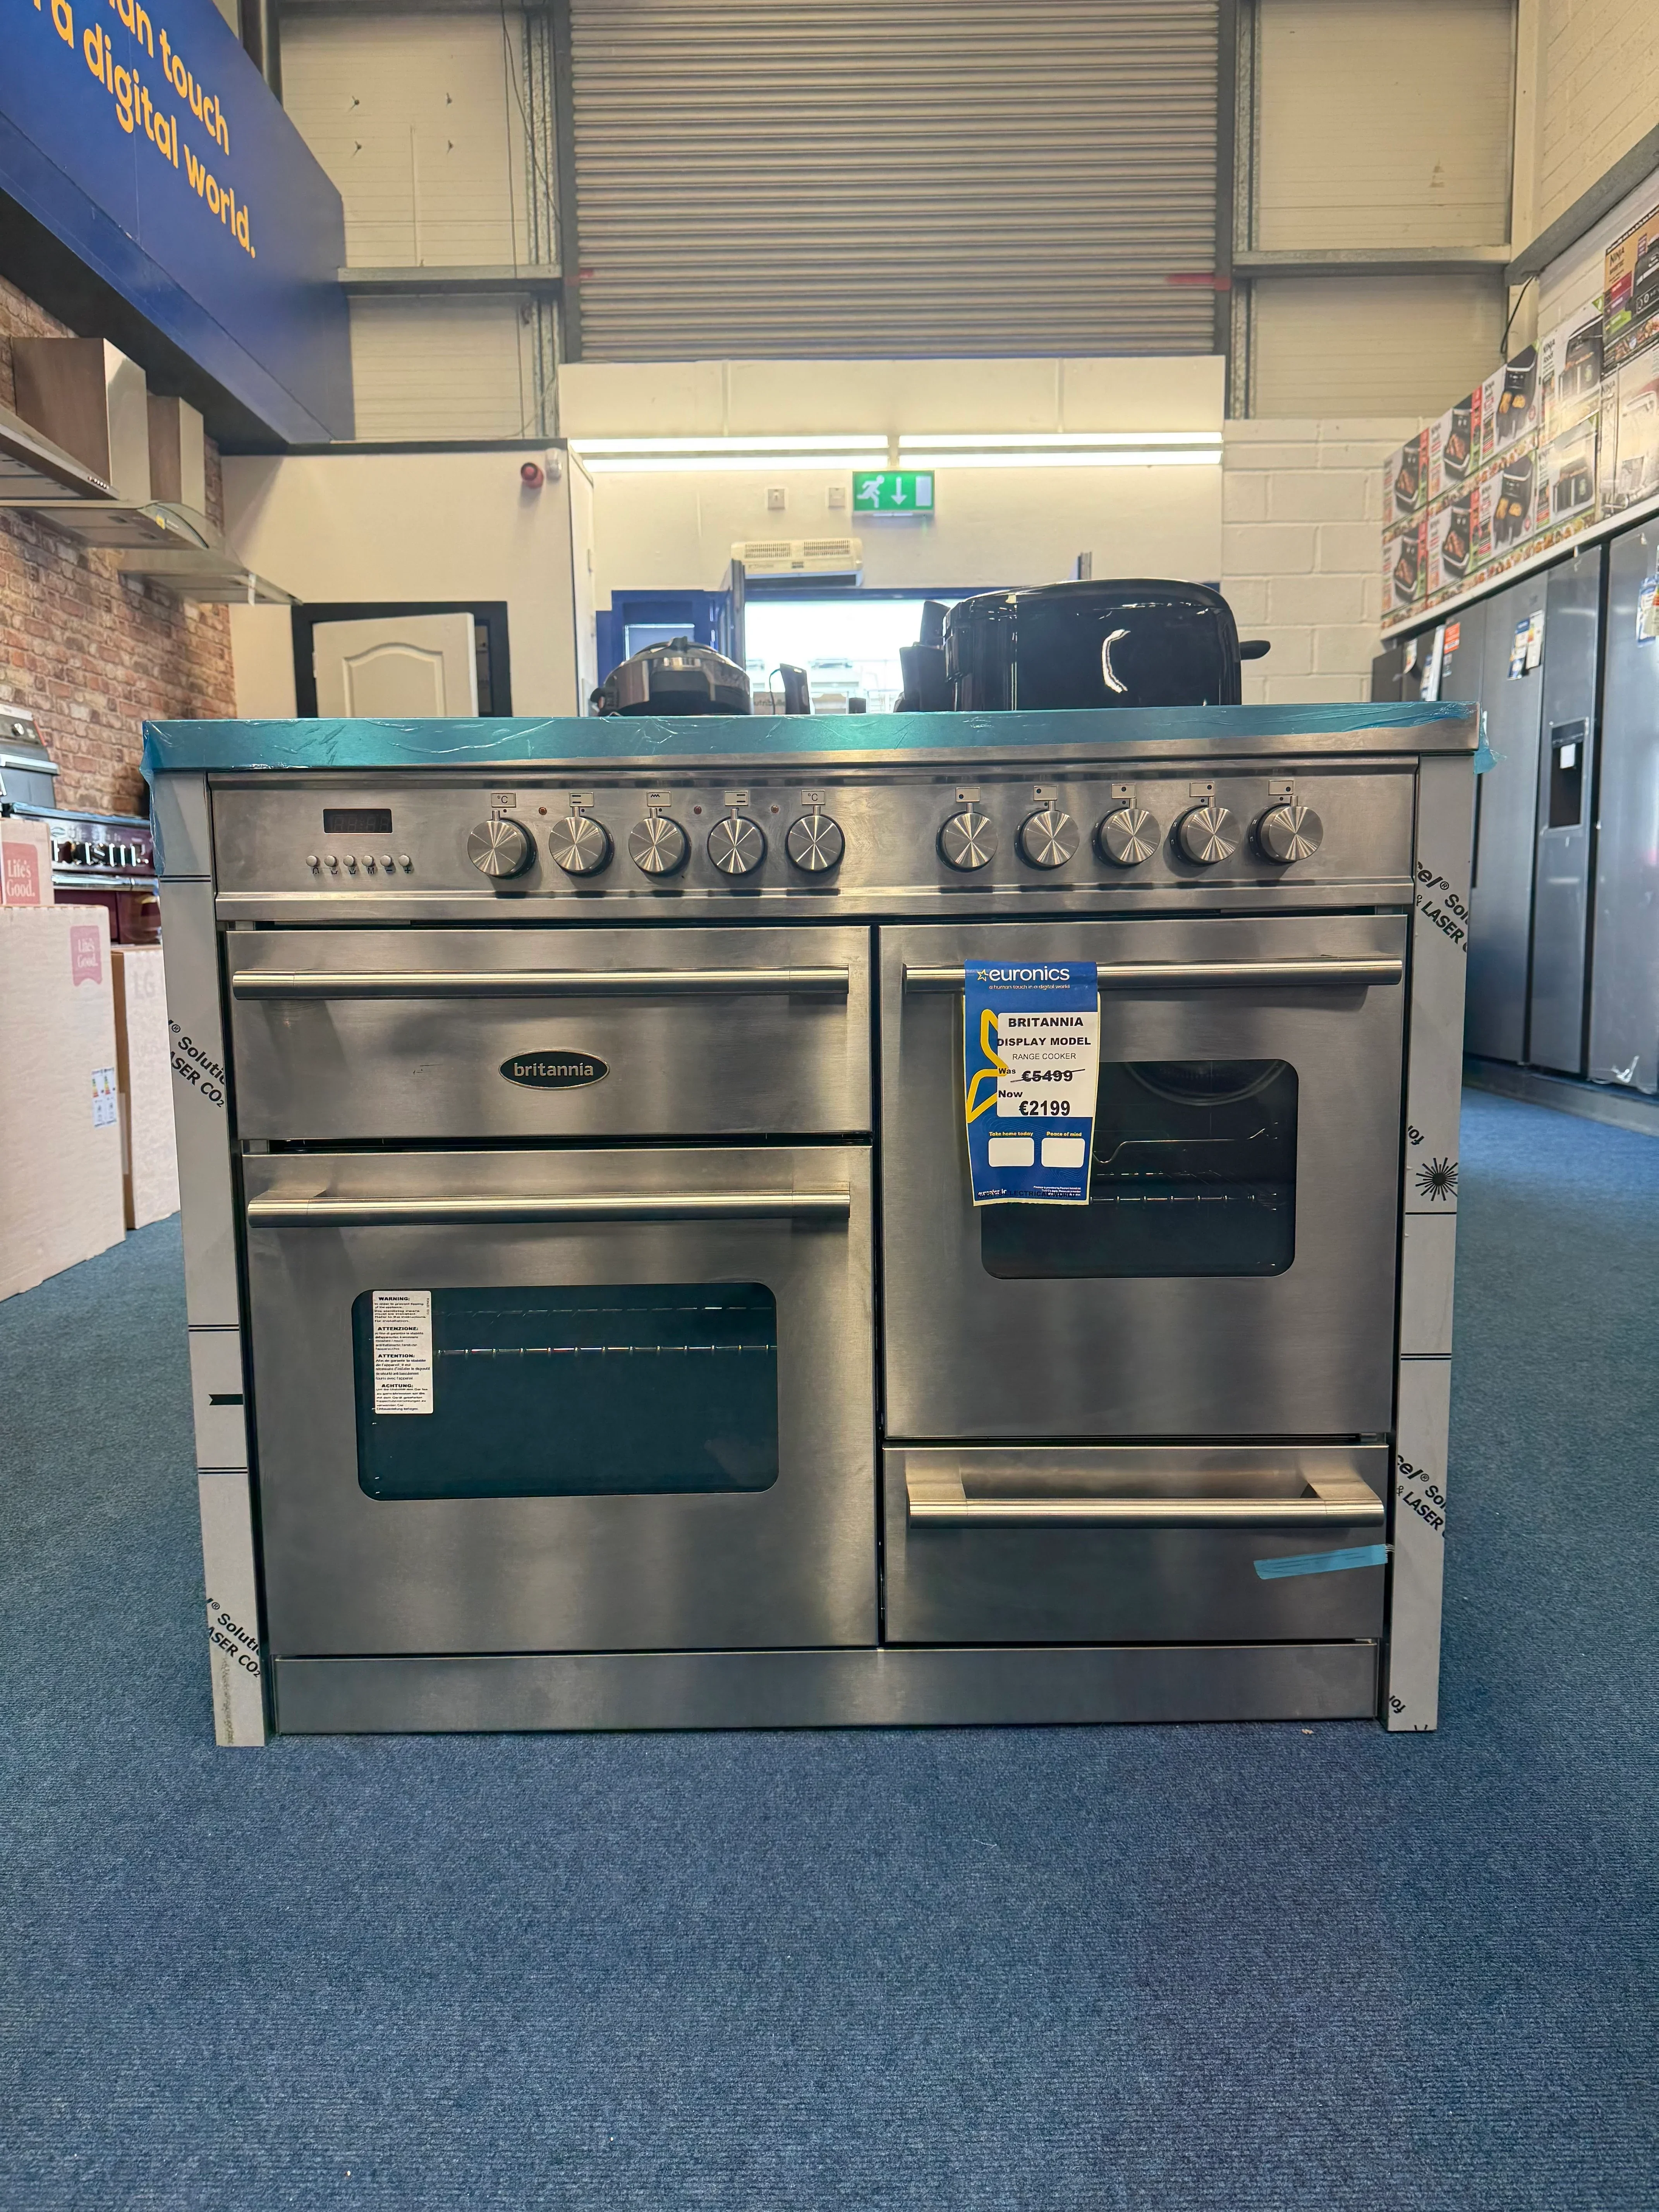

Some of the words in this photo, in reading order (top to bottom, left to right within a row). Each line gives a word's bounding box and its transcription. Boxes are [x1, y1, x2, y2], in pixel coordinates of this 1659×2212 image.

[109, 0, 153, 58] an
[159, 28, 230, 155] touch
[52, 0, 74, 49] a
[83, 23, 179, 169] digital
[183, 144, 256, 259] world.
[7, 859, 31, 878] Life's
[6, 880, 35, 898] Good.
[1444, 894, 1468, 926] Sol
[1421, 901, 1464, 944] LASER
[989, 966, 1070, 982] euronics
[1008, 1017, 1084, 1027] BRITANNIA
[998, 1038, 1046, 1046] DISPLAY
[514, 1063, 593, 1077] britannia
[1021, 1070, 1073, 1082] €5499
[998, 1090, 1023, 1098] Now
[1019, 1100, 1070, 1116] €2199
[1425, 1485, 1446, 1512] Sol
[1403, 1491, 1443, 1532] LASER
